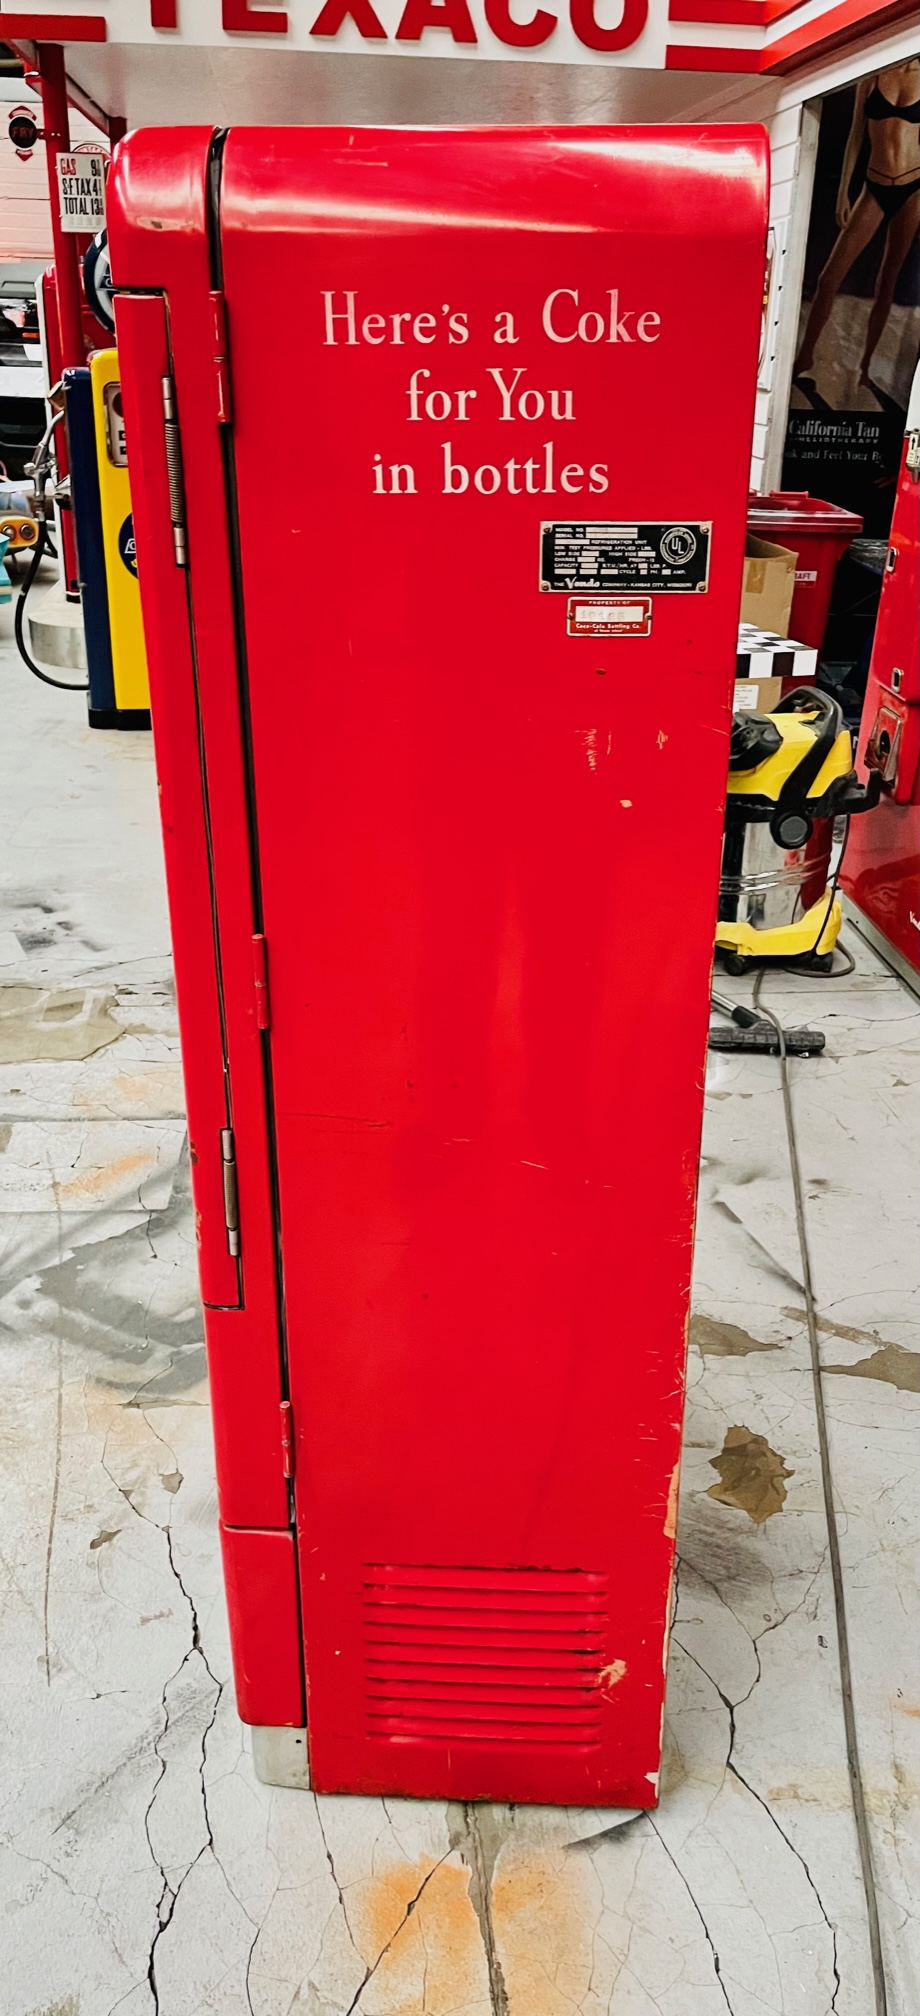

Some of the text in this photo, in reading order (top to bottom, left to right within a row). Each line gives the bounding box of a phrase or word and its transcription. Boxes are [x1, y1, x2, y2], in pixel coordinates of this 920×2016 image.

[60, 158, 76, 176] GAS
[75, 178, 92, 196] TAX
[64, 197, 89, 215] TOTAL
[320, 288, 661, 345] Here's a Coke
[406, 368, 576, 420] for You
[788, 420, 880, 437] California Tan
[802, 450, 820, 459] and
[824, 450, 842, 459] Feel
[846, 451, 868, 460] Your
[372, 441, 609, 494] in bottles
[672, 537, 684, 554] UL
[564, 576, 600, 589] Vendo
